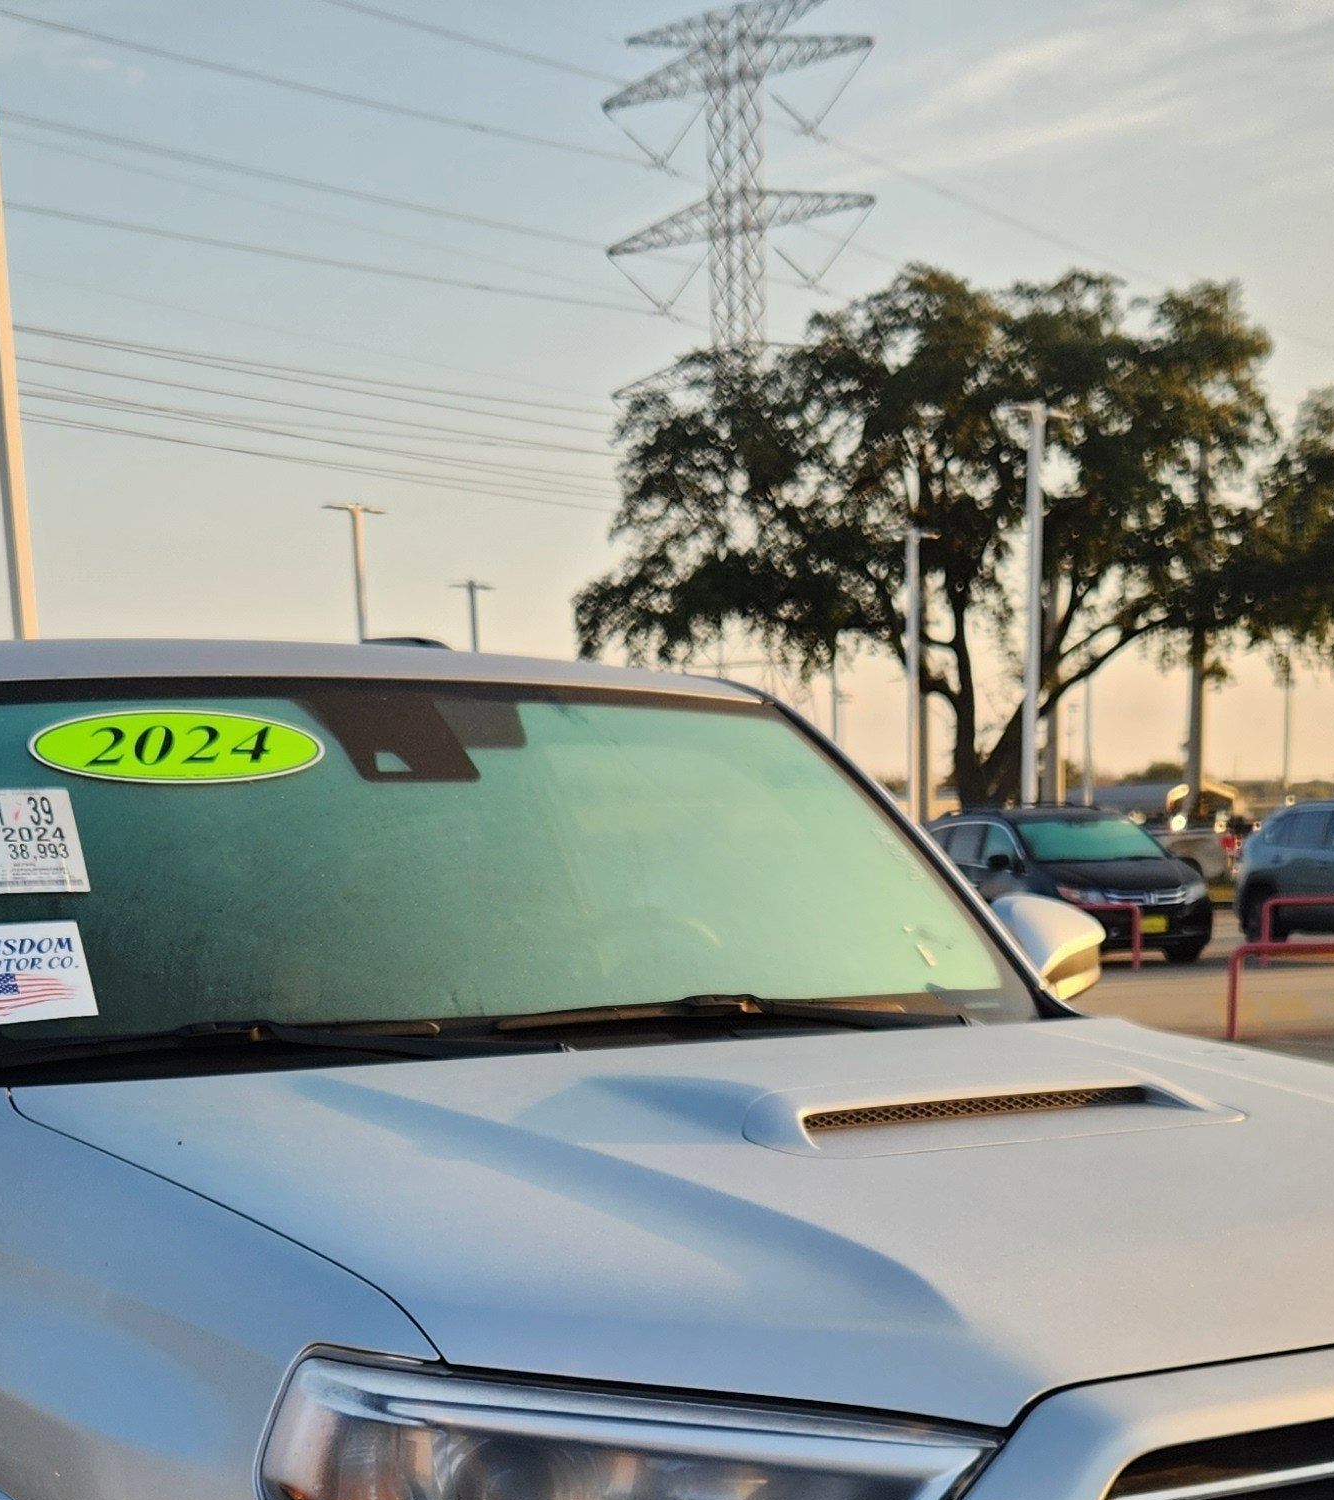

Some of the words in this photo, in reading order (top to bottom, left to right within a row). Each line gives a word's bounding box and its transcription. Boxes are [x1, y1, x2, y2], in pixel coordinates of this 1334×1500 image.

[84, 725, 273, 767] 2024
[28, 796, 54, 826] 39
[2, 827, 66, 842] 2024
[8, 843, 70, 862] 38,993
[45, 956, 79, 970] CO.
